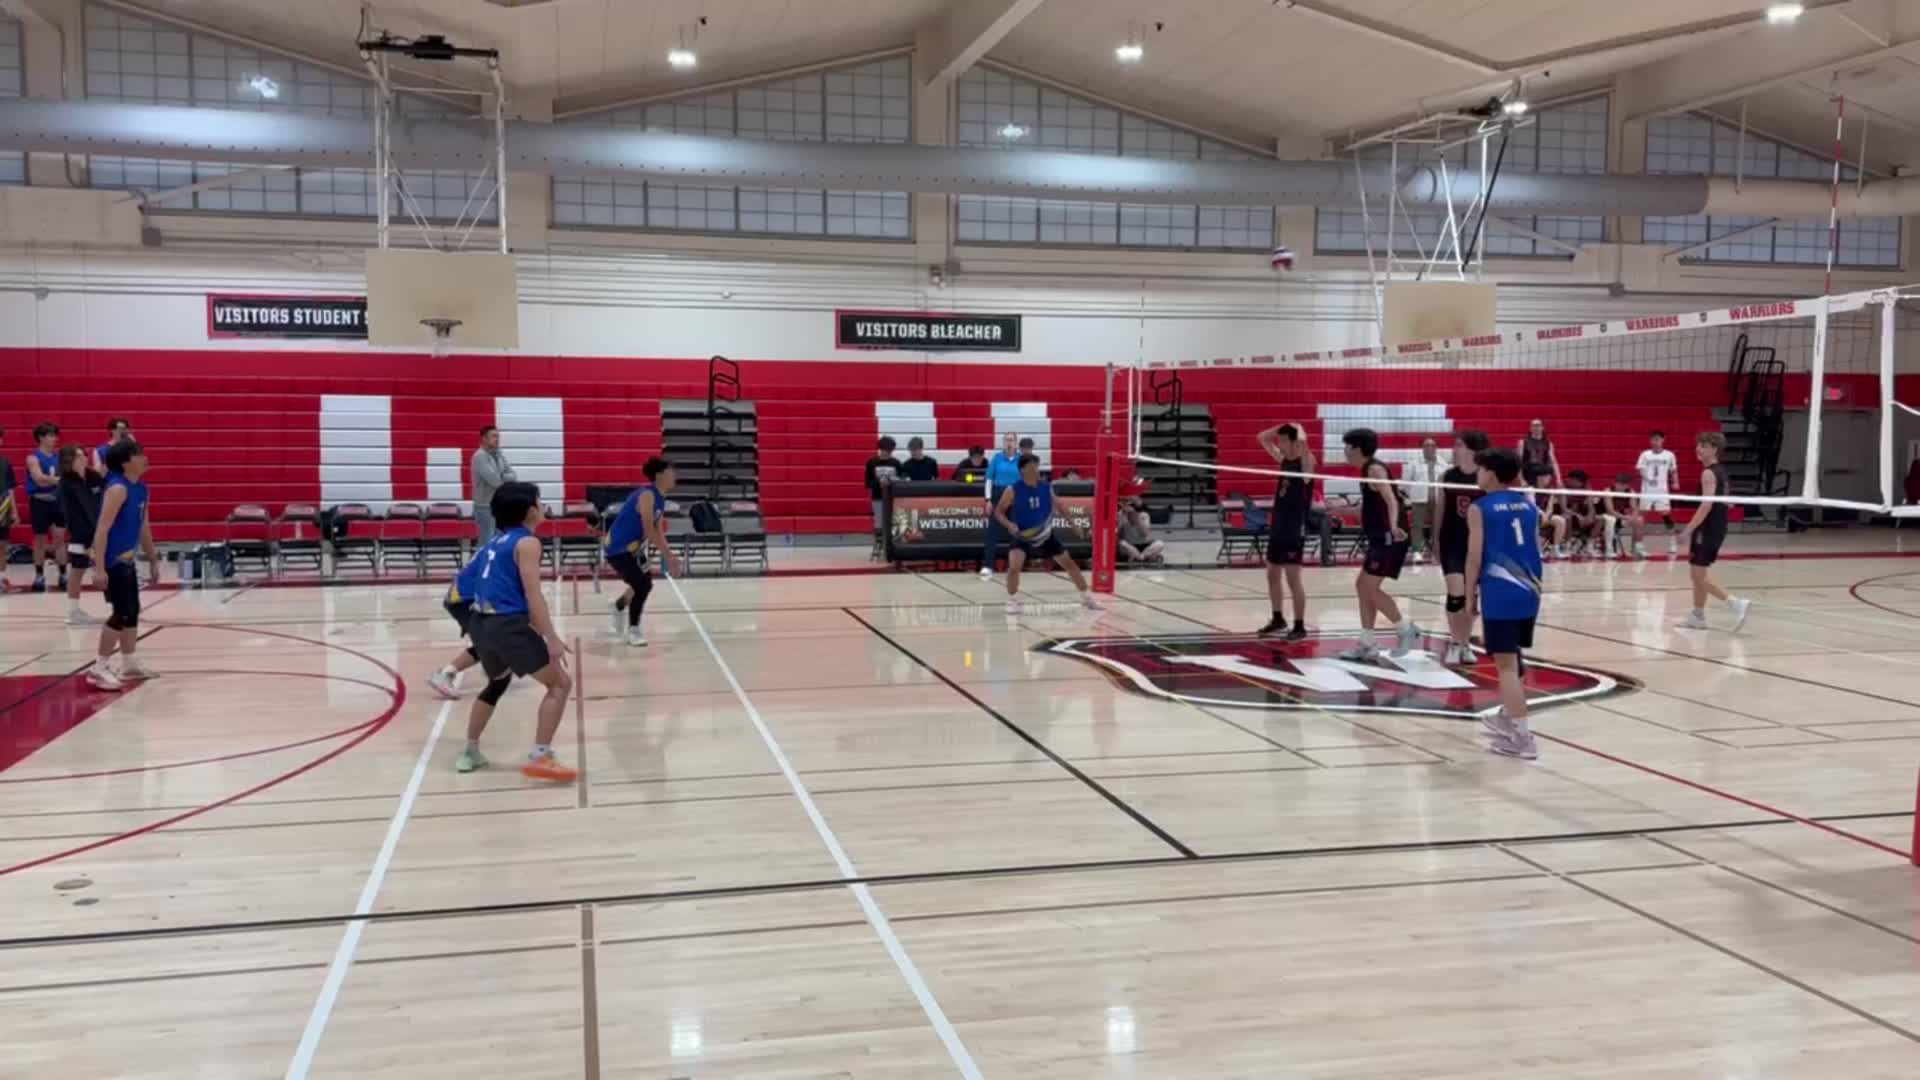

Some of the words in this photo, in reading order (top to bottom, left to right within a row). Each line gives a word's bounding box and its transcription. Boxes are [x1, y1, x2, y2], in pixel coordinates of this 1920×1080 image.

[215, 306, 289, 324] VISITORS
[294, 308, 361, 325] STUDENT
[1729, 302, 1795, 320] WARRIORS
[856, 323, 926, 338] VISITORS
[931, 324, 1001, 340] BLEACHER
[928, 507, 967, 515] WELCOME
[971, 507, 983, 515] TO
[1511, 517, 1524, 546] 1
[482, 549, 496, 579] 7
